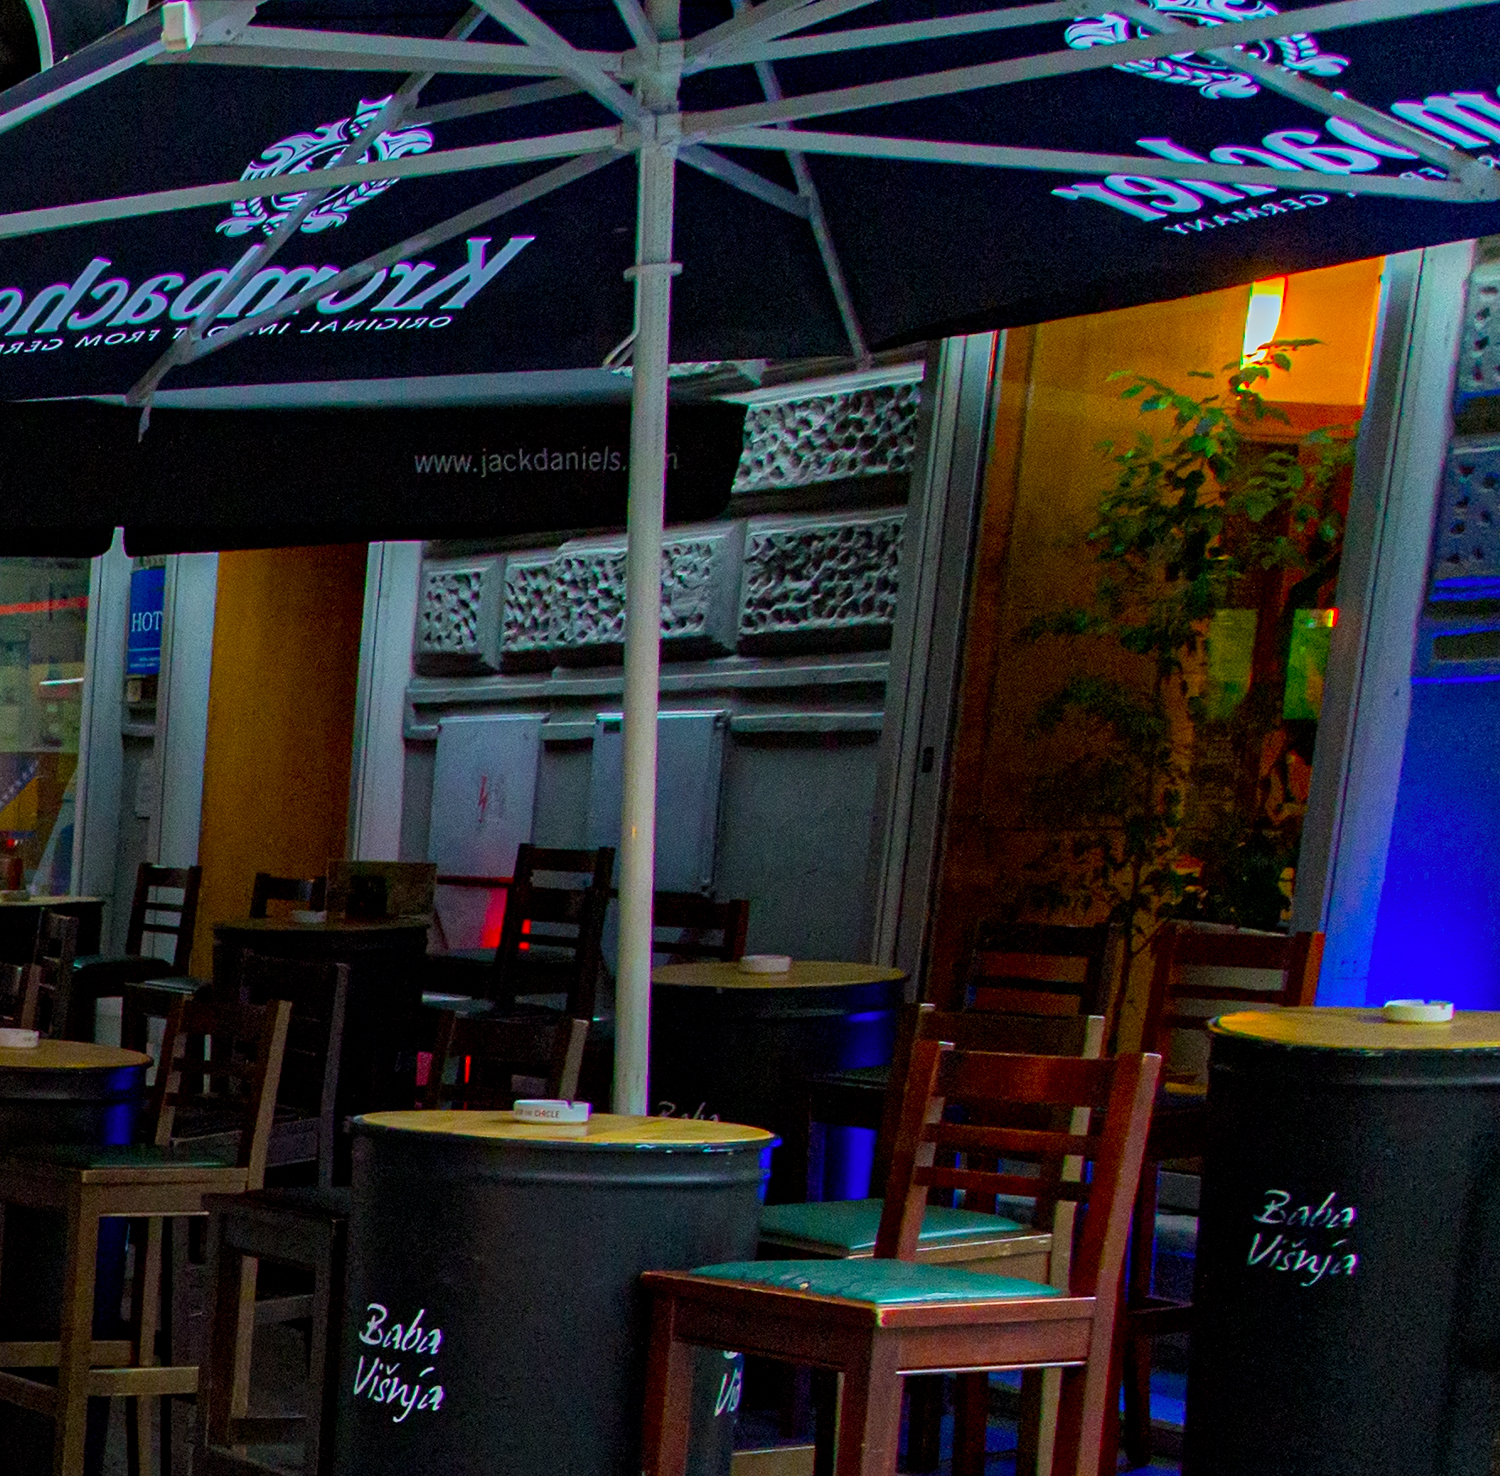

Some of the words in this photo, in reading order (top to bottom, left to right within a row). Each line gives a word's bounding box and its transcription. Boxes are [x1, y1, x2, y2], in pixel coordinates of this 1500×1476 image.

[1254, 1189, 1357, 1231] Baba
[1246, 1232, 1358, 1288] Višnja
[360, 1303, 444, 1356] Baba
[353, 1355, 445, 1424] Višnja
